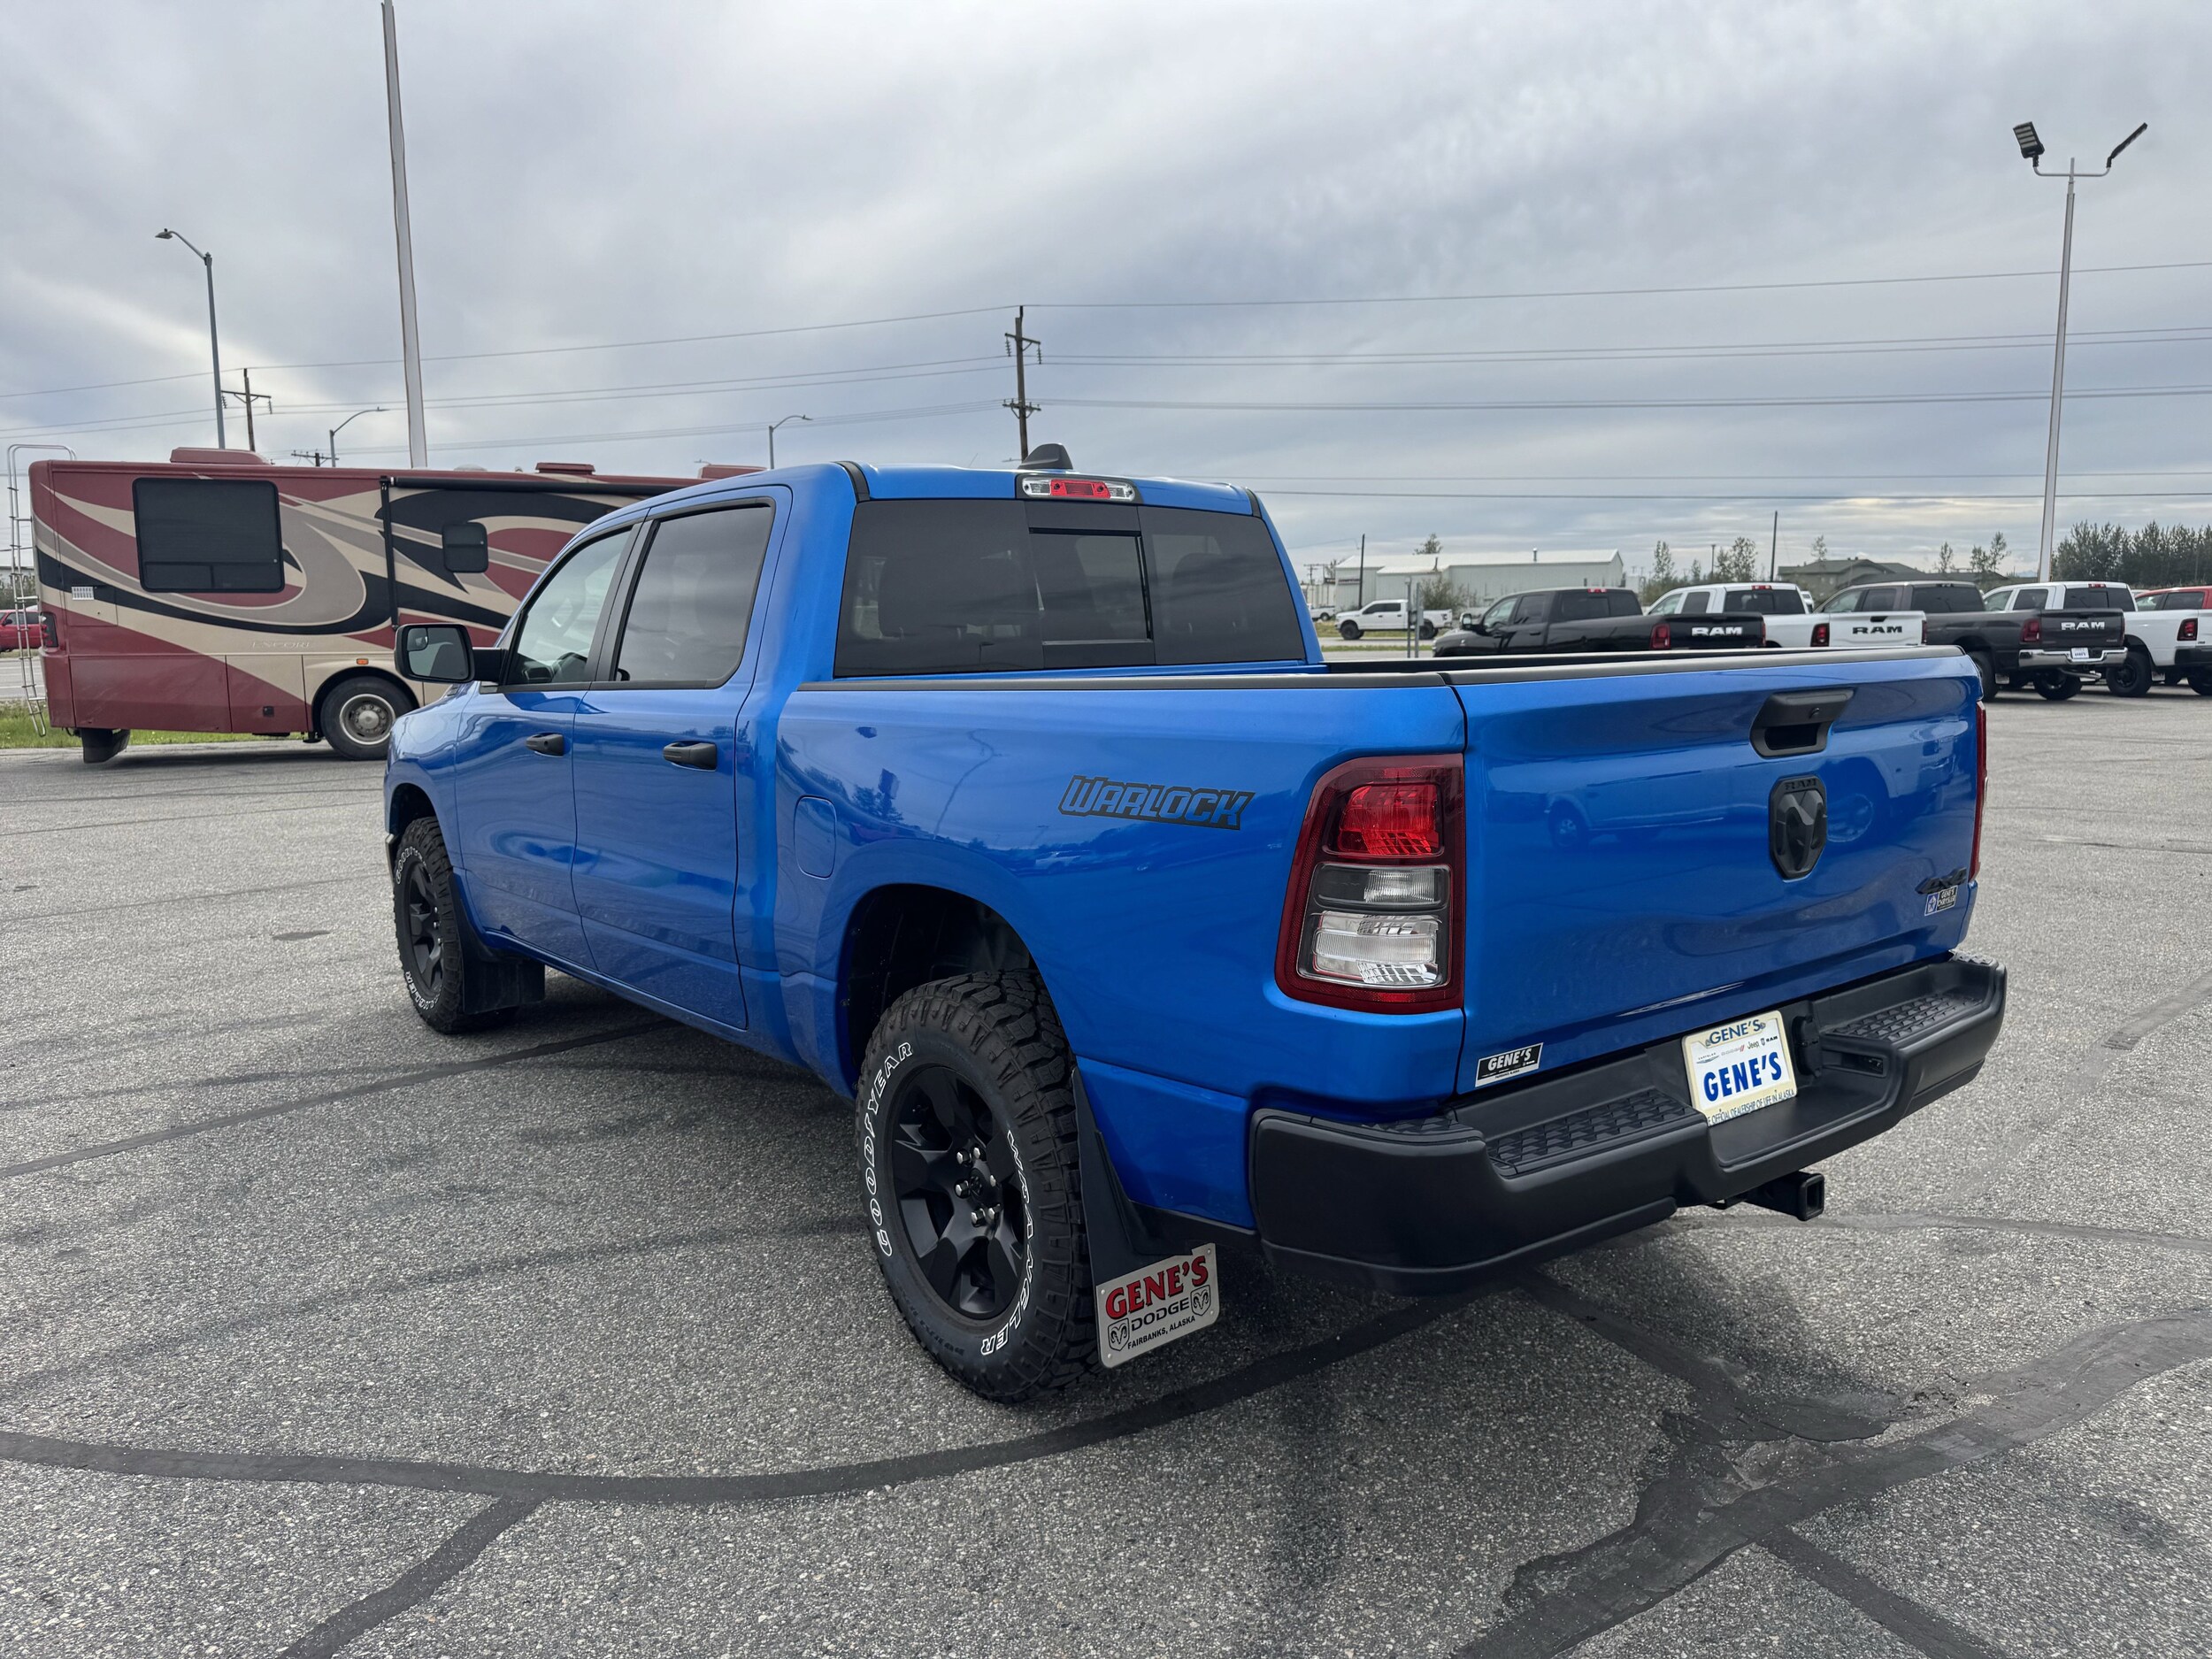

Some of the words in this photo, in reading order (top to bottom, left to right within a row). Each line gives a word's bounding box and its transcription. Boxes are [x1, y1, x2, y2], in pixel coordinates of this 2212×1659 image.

[1691, 626, 1743, 636] RAM
[1852, 626, 1903, 634] RAM
[2061, 621, 2106, 631] RAM
[1057, 775, 1256, 830] WARLOCK
[1709, 1019, 1761, 1045] GENE'S
[1747, 1041, 1760, 1050] Jeep
[1487, 1048, 1532, 1071] GENE'S
[1703, 1051, 1782, 1102] GENE'S
[1756, 1099, 1763, 1109] OF
[1778, 1089, 1794, 1101] ALASKA
[864, 1041, 913, 1256] GOODYEAR
[979, 1129, 1034, 1356] WRANGLER
[1105, 1255, 1209, 1320] GENE'S
[1131, 1297, 1190, 1332] DODGE
[1127, 1326, 1168, 1349] FAIRBANKS,
[1169, 1315, 1195, 1332] ALASKA
